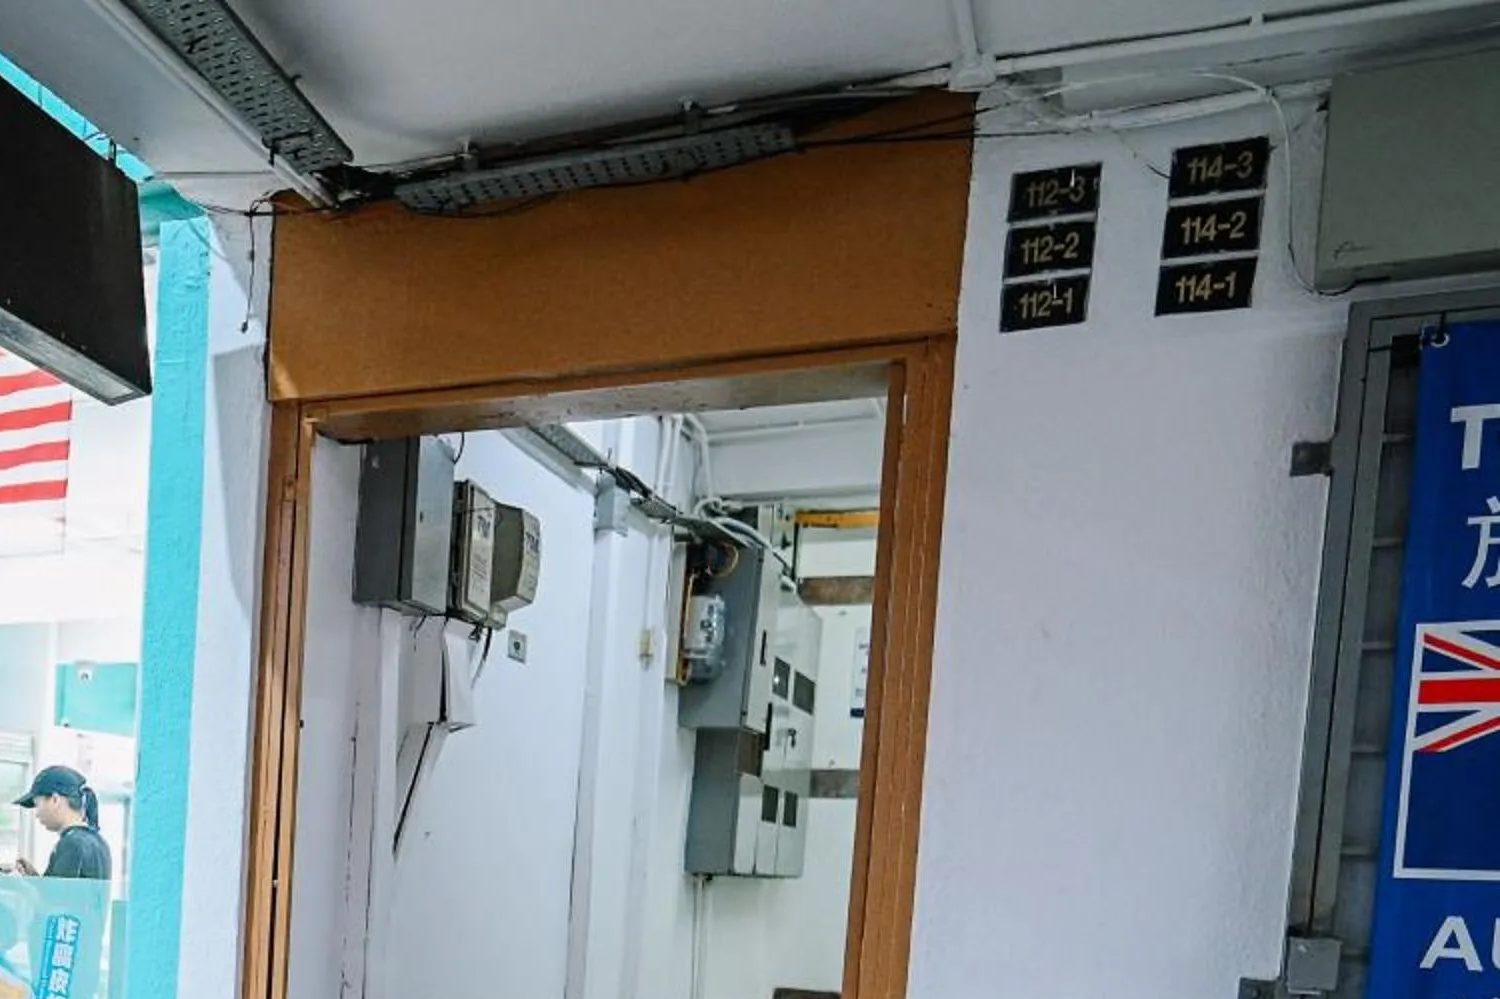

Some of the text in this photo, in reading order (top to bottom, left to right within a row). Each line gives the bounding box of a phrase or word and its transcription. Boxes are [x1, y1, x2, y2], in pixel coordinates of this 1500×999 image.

[1187, 151, 1254, 183] 114-3
[1026, 174, 1085, 207] 112-3
[1180, 211, 1247, 244] 114-2
[1020, 232, 1080, 265] 112-2
[1019, 286, 1074, 319] 112-1
[1175, 271, 1237, 303] 114-1
[1419, 914, 1500, 972] A
